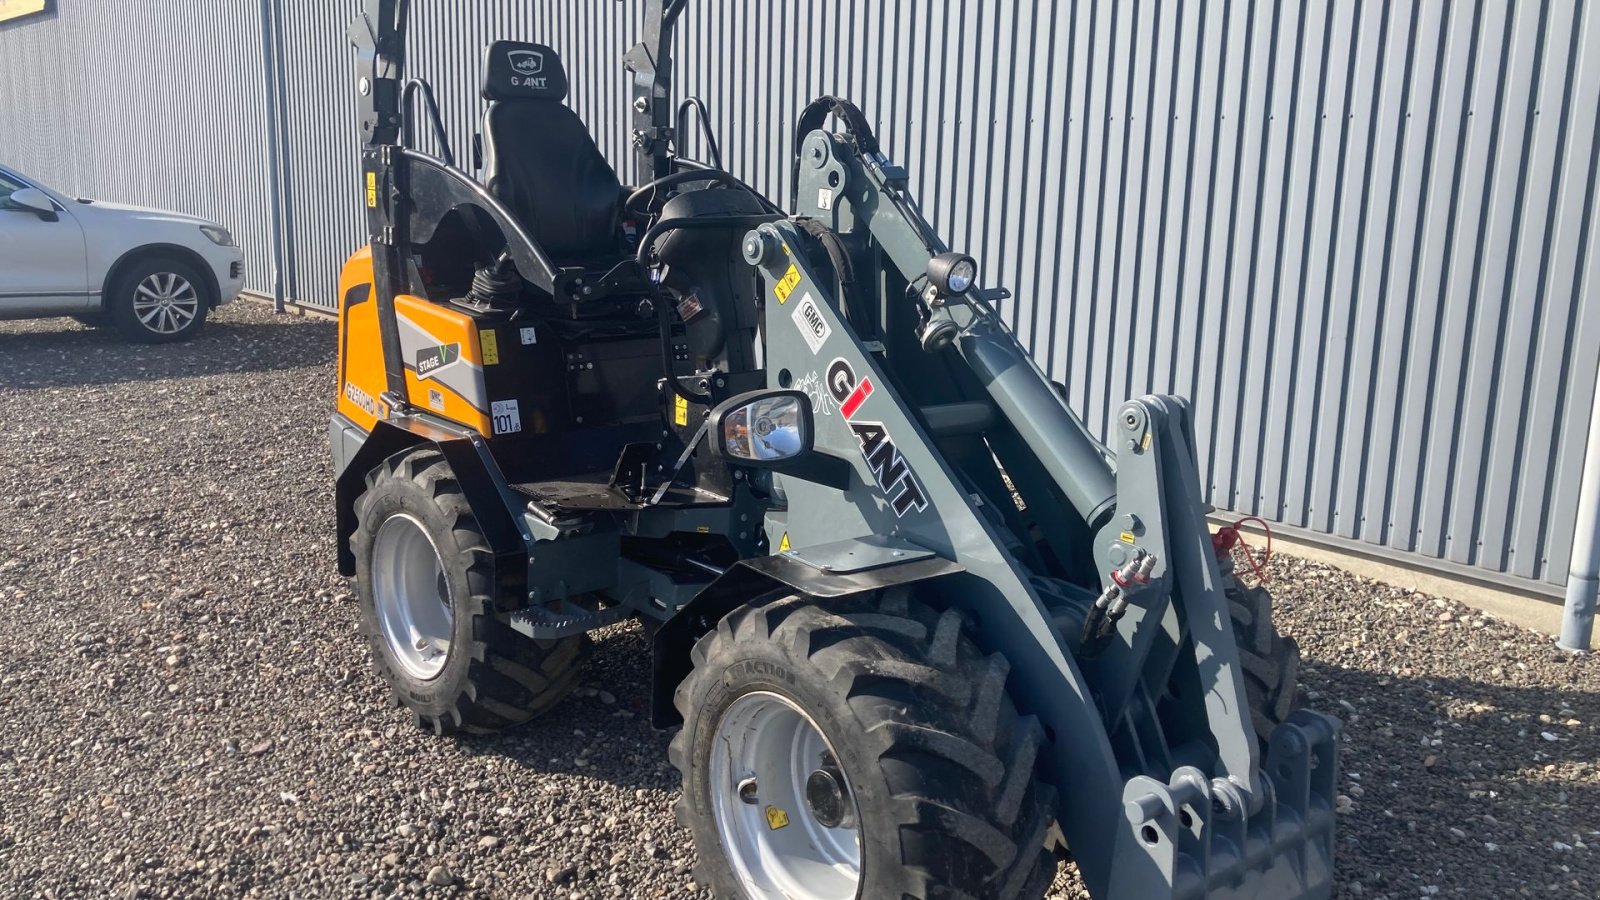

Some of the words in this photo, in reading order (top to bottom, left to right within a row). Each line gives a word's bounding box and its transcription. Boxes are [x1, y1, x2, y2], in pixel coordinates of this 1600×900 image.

[804, 305, 823, 335] GMC
[418, 355, 439, 372] STAGE
[494, 414, 513, 433] 101
